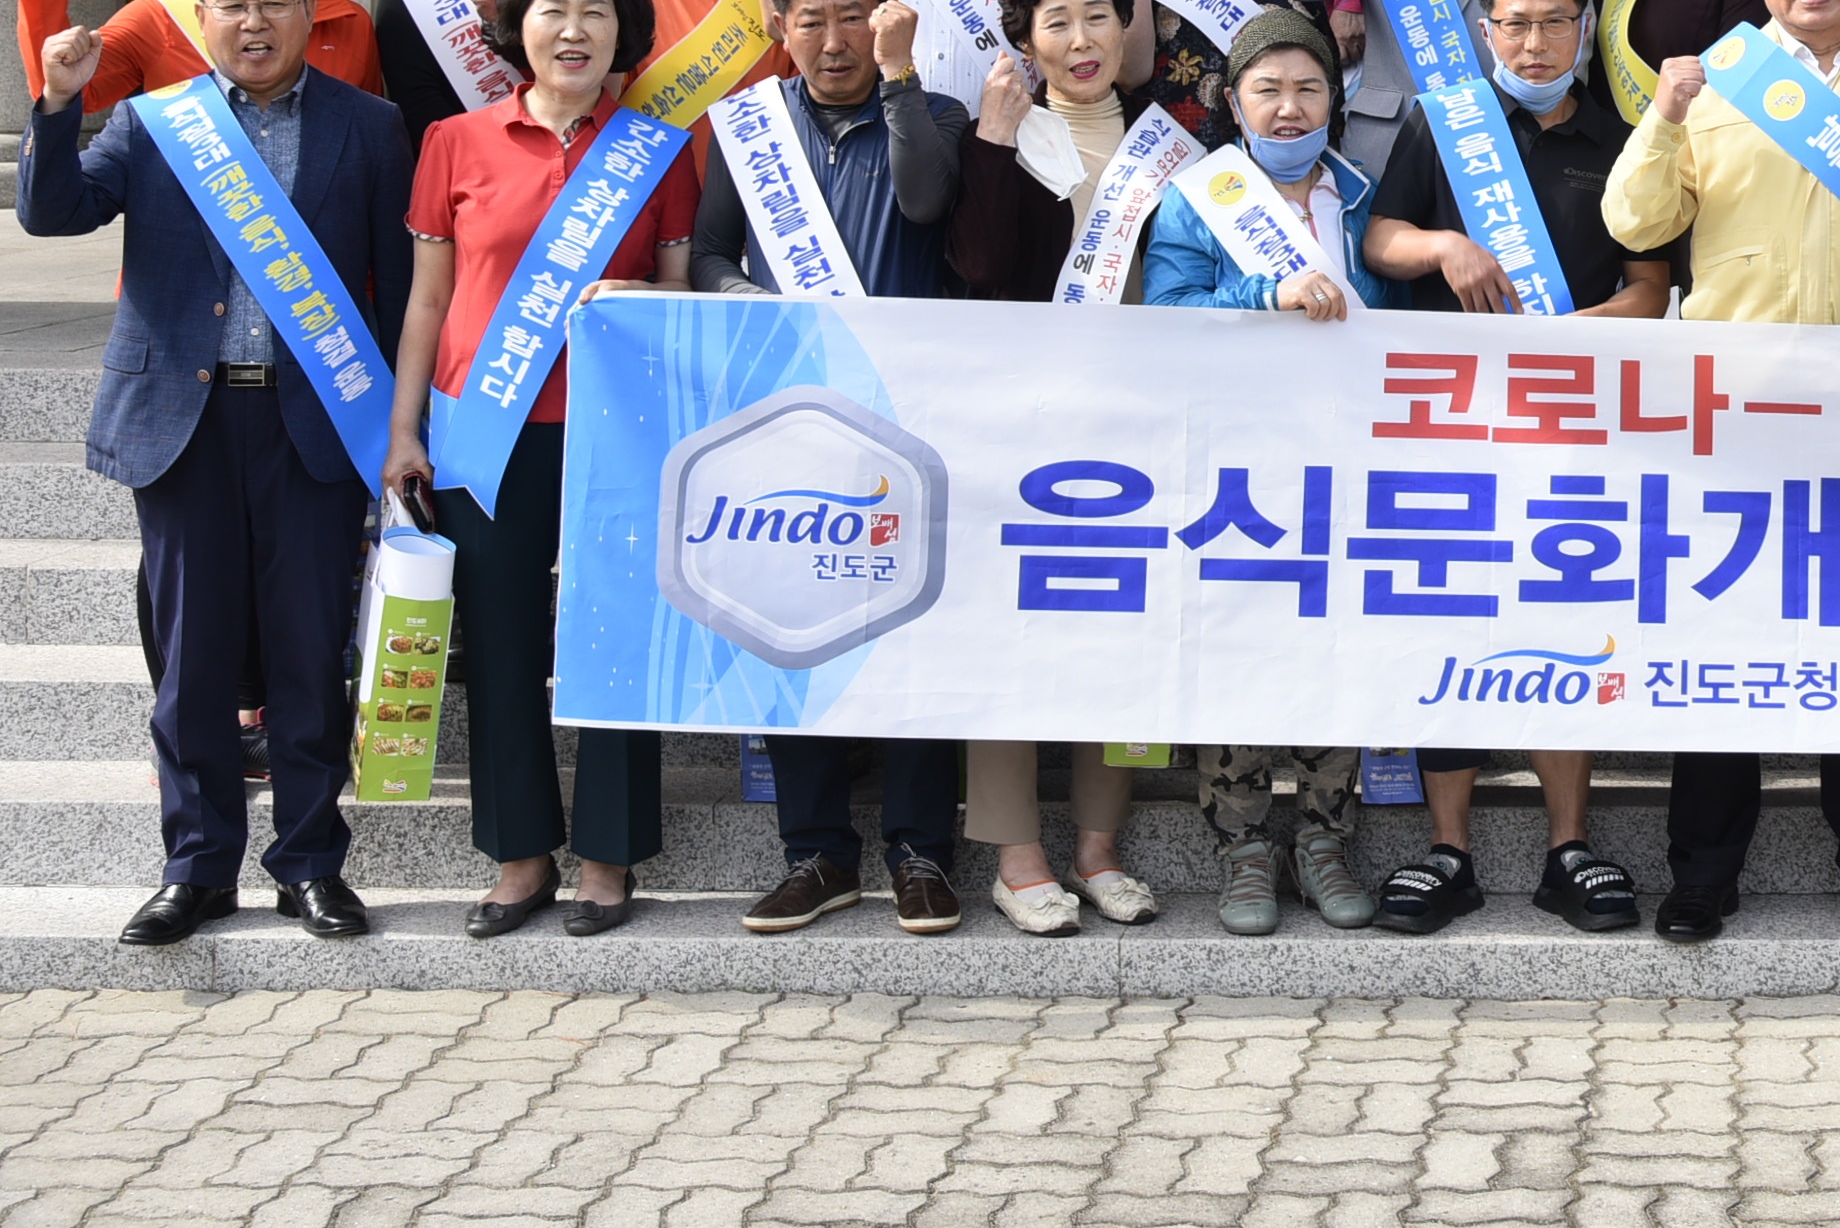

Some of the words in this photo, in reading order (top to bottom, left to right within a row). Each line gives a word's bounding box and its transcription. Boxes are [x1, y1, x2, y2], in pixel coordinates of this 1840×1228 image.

[711, 22, 749, 65] 조리된
[1399, 5, 1439, 66] 운동에
[160, 95, 232, 172] 음식점3대
[1435, 87, 1485, 131] 남은
[604, 118, 668, 183] 간소한
[1128, 118, 1171, 159] 식습관
[1454, 131, 1503, 176] 음식
[1104, 164, 1138, 201] 개선
[546, 179, 630, 272] 상차림을
[744, 141, 809, 239] 상차림을
[783, 235, 836, 290] 실천
[1073, 209, 1111, 275] 운동에
[1234, 204, 1308, 281] 음식점3대
[1472, 178, 1536, 272] 재사용을
[517, 271, 573, 328] 실천
[314, 325, 358, 369] 청결
[479, 324, 543, 408] 합시다
[332, 360, 374, 403] 운동
[685, 490, 865, 546] Jindo
[811, 554, 898, 582] 진도군
[1417, 654, 1592, 705] Jindo
[1643, 659, 1838, 712] 진도군청
